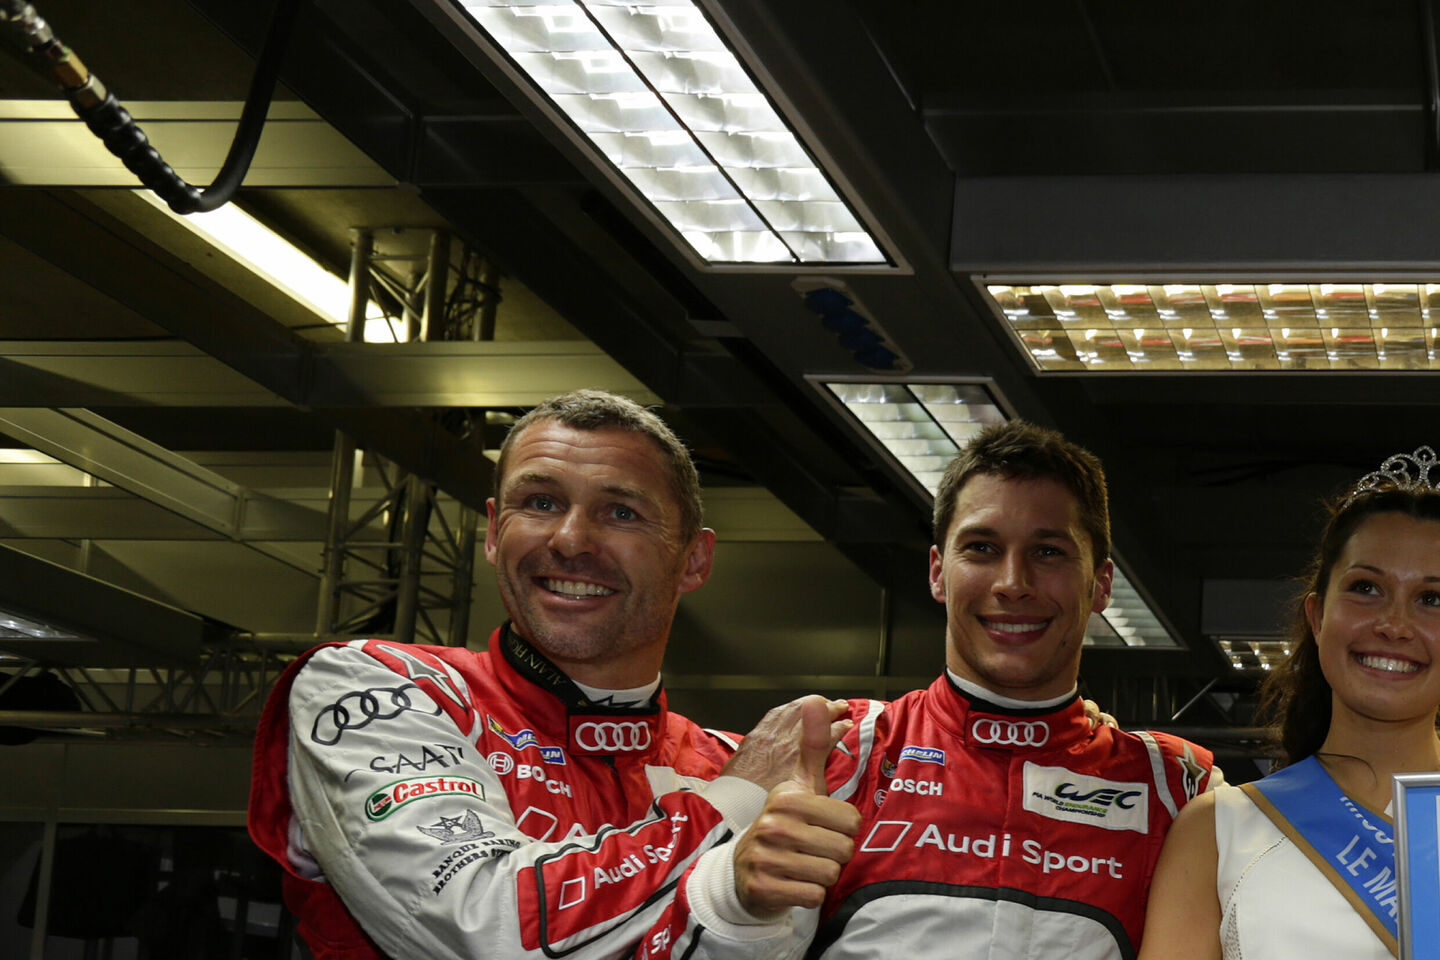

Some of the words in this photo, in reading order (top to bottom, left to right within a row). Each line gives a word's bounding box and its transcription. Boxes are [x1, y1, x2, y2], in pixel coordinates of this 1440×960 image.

[392, 778, 480, 804] Castrol
[516, 764, 573, 798] BOCH
[889, 777, 943, 796] OSCH
[432, 843, 479, 879] BANQUE
[914, 823, 1011, 857] Audi
[1022, 838, 1123, 879] Sport
[433, 849, 489, 896] BROTHERS
[593, 853, 646, 889] Audi
[1335, 834, 1377, 877] LE
[1363, 866, 1399, 924] MA
